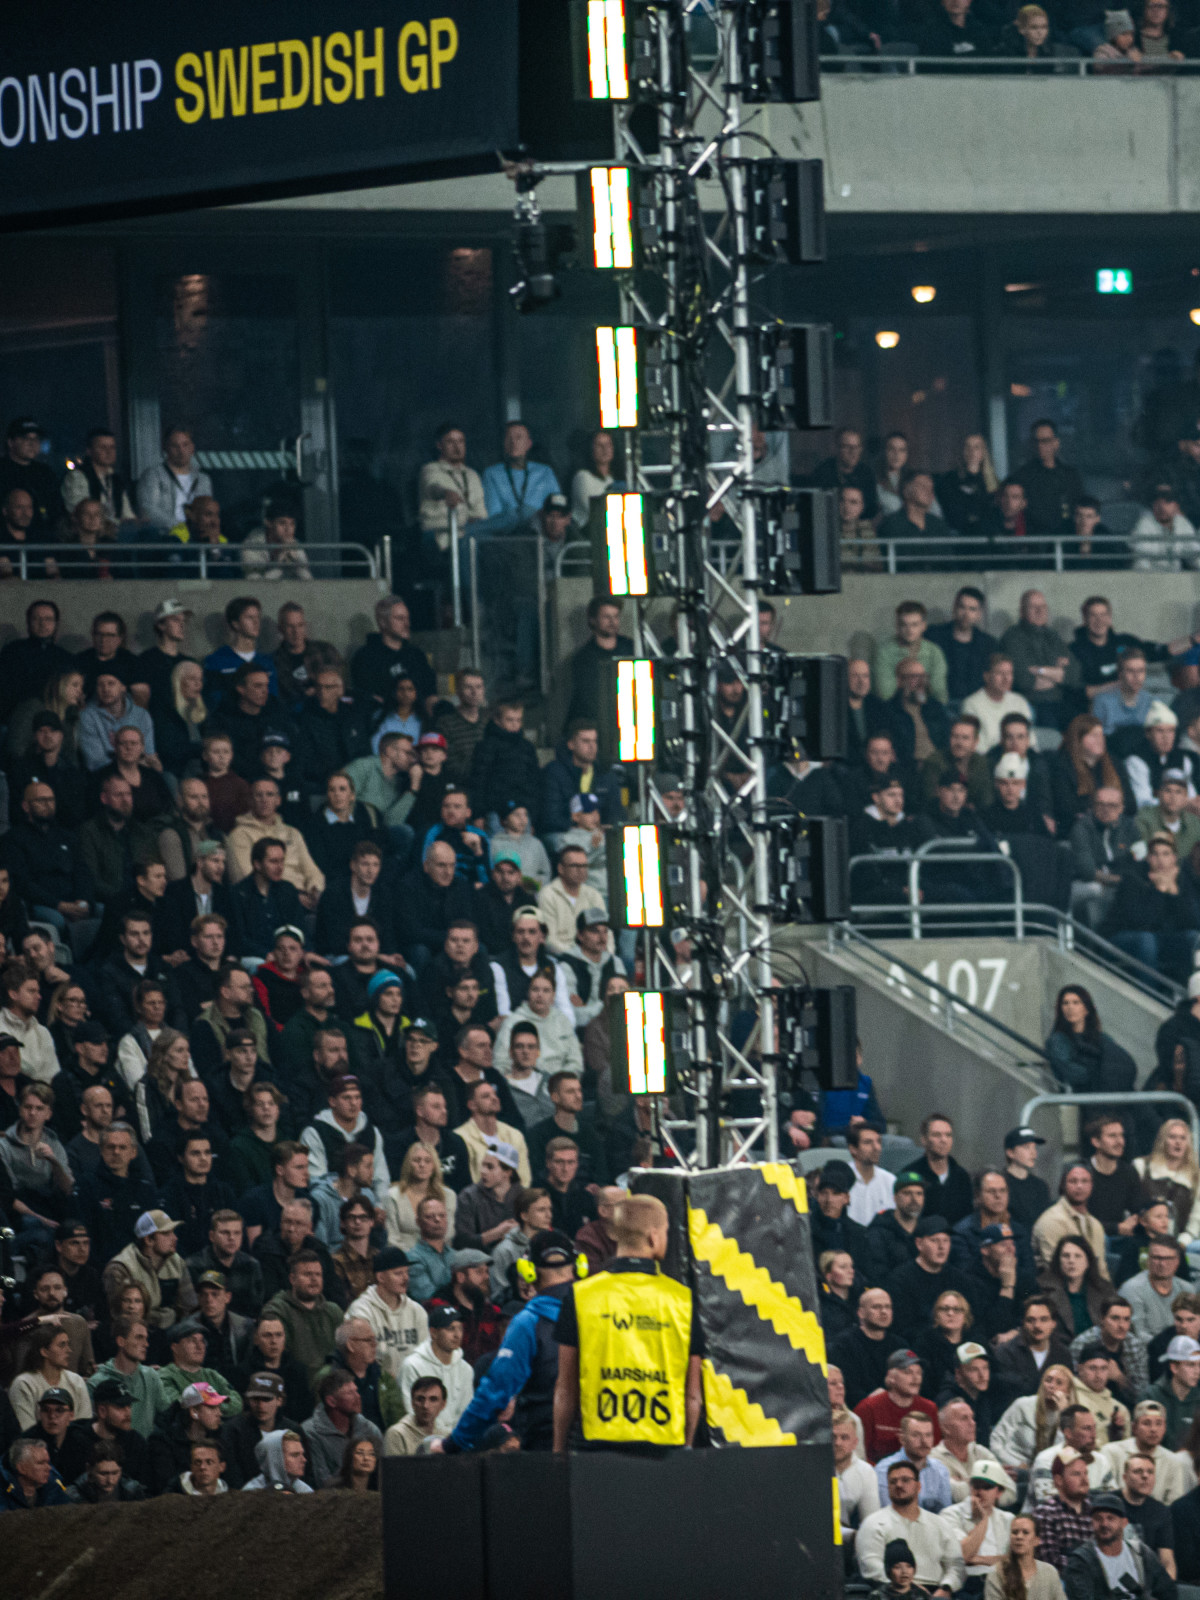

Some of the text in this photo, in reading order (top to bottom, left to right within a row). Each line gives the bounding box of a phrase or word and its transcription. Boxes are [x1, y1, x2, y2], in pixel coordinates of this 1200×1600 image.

[0, 17, 458, 147] ONSHIP SWEDISH GP
[601, 1367, 668, 1385] MARSHAL
[597, 1387, 671, 1426] 006
